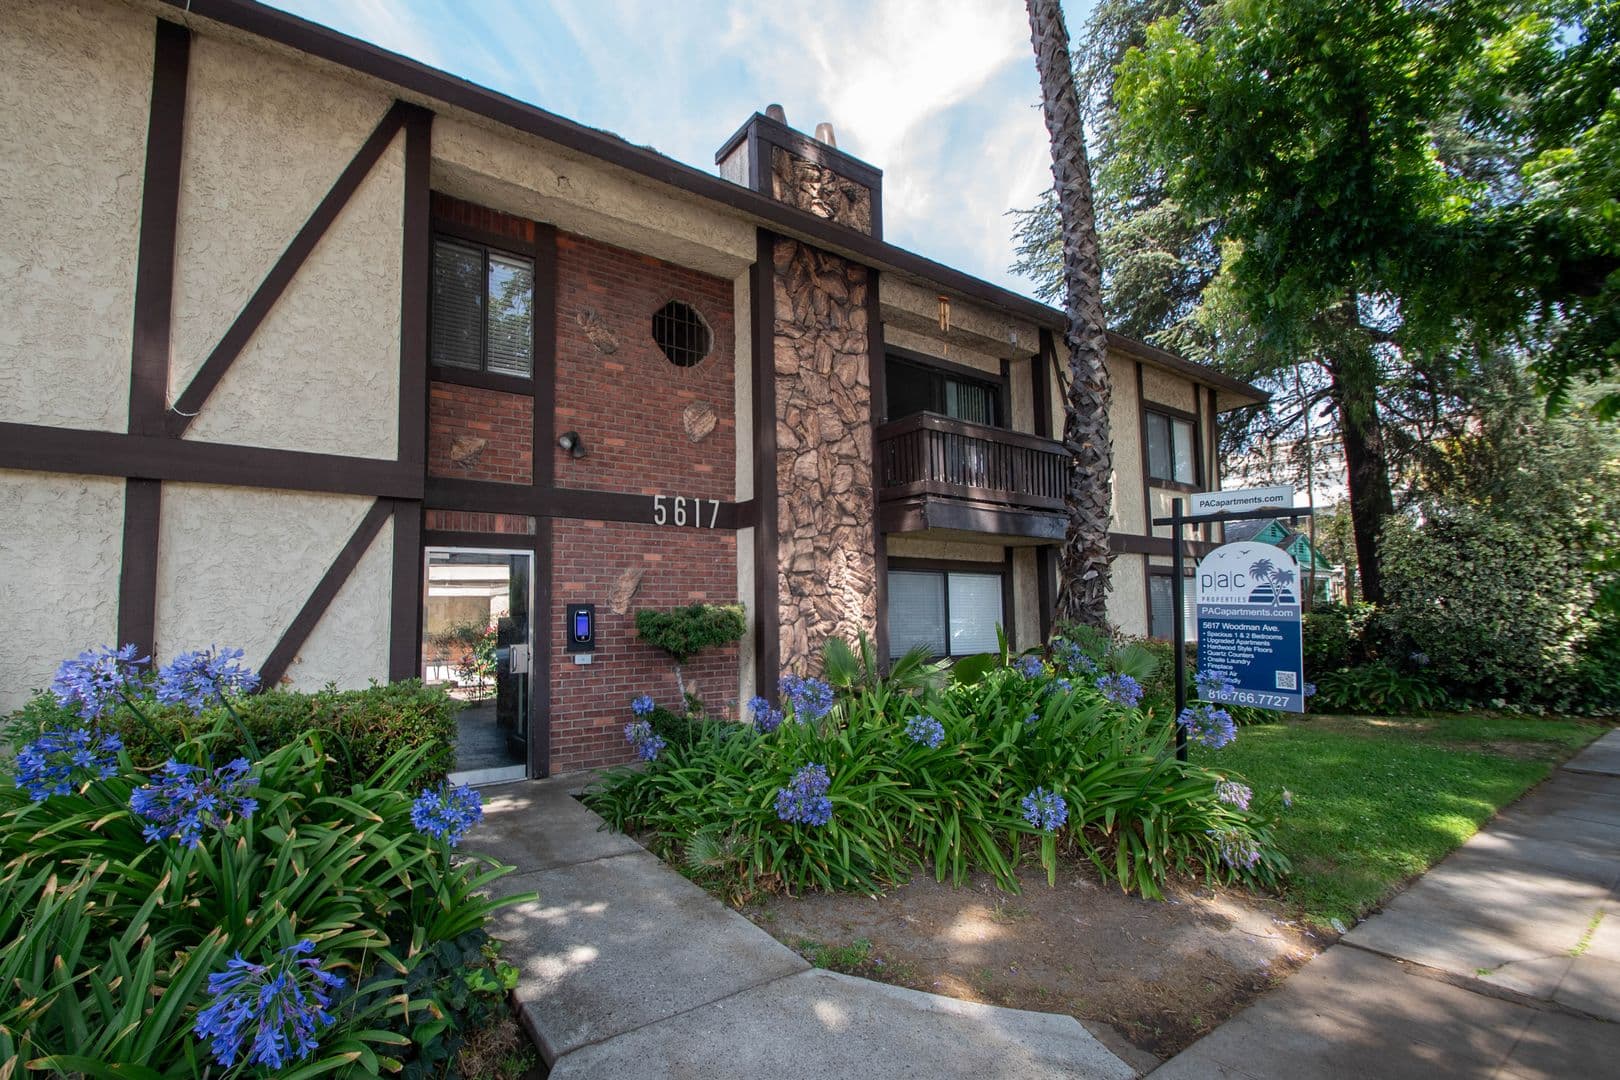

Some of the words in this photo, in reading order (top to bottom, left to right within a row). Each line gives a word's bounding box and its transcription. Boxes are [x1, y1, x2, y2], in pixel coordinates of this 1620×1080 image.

[1199, 495, 1284, 508] PACapartments.com
[654, 494, 720, 528] 5617
[1201, 607, 1293, 616] PACapartments.com
[1222, 623, 1260, 631] Woodman
[1226, 658, 1251, 666] Laundry
